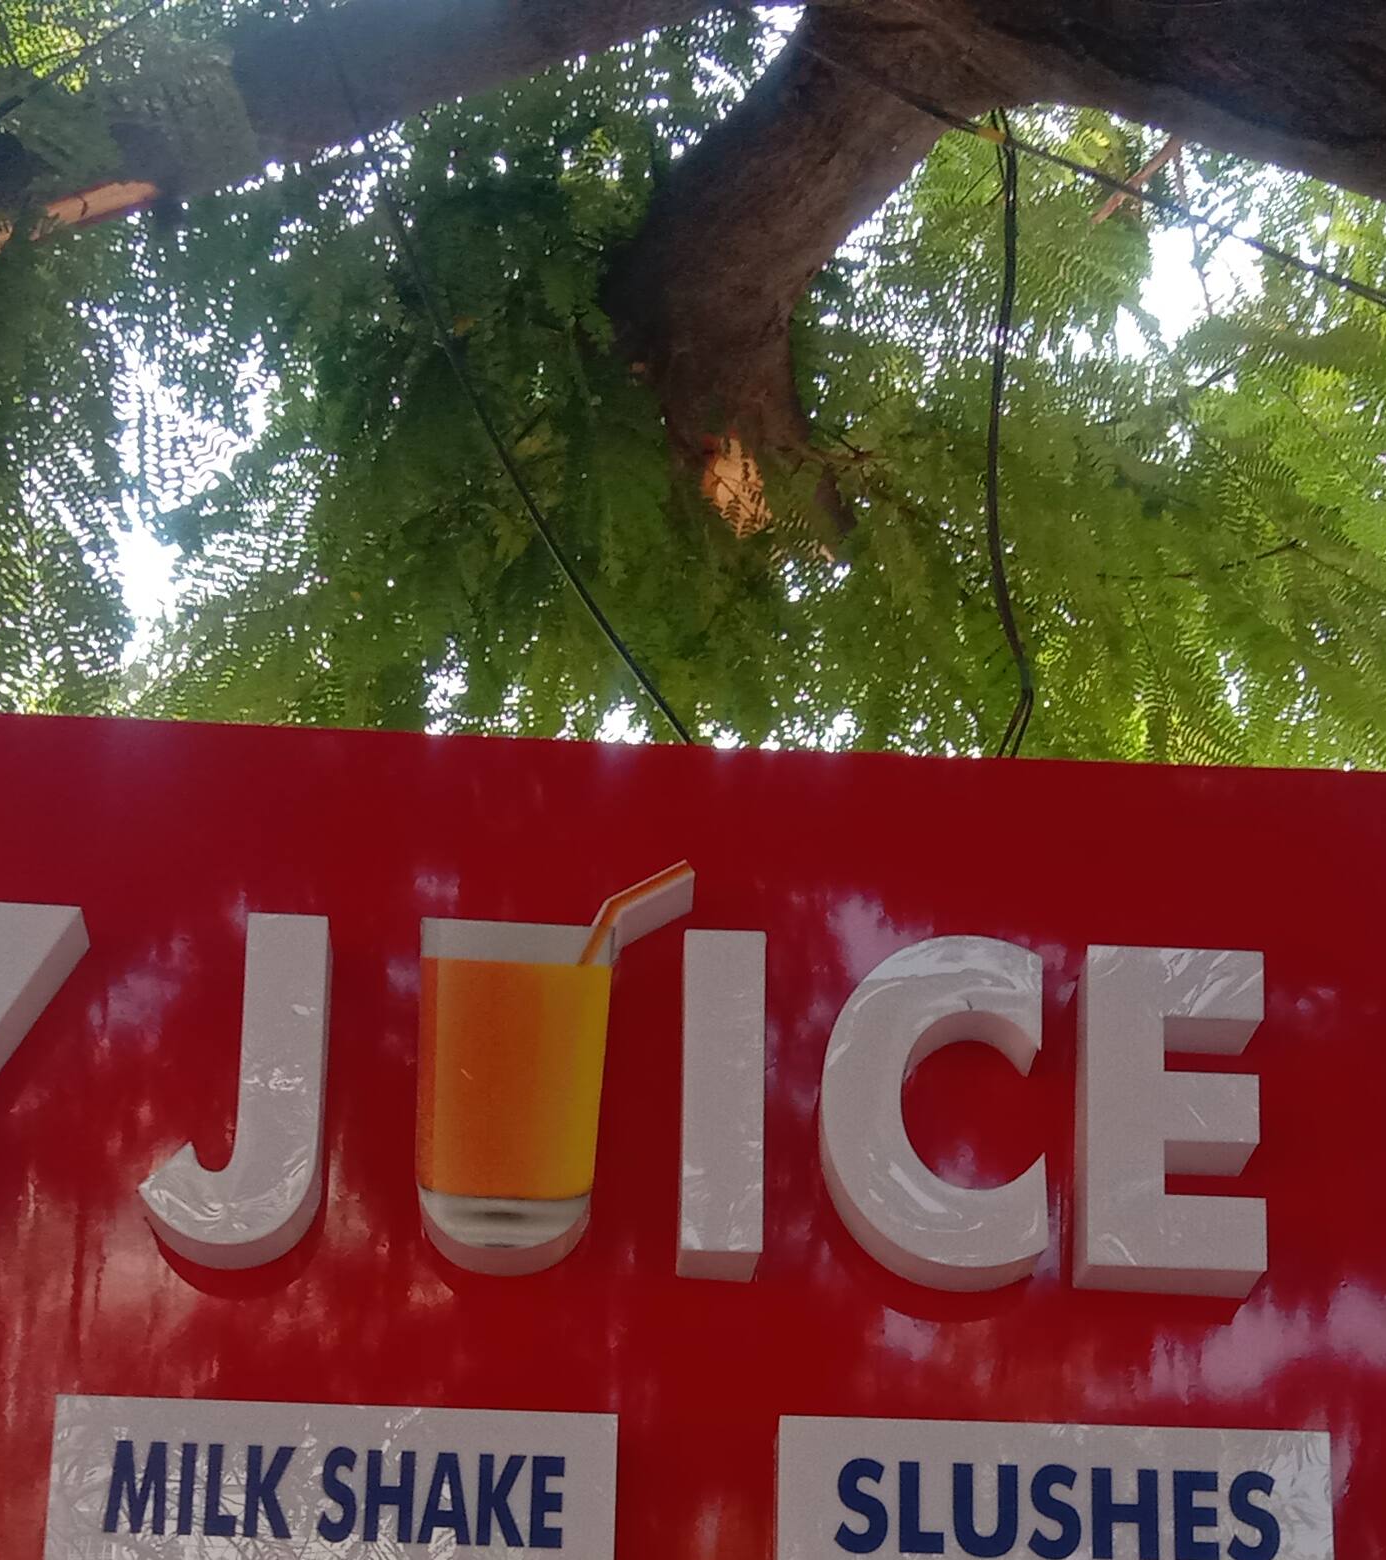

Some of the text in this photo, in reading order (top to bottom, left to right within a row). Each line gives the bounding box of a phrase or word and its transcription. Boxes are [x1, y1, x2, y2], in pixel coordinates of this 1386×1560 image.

[137, 860, 1269, 1299] JUICE
[103, 1439, 566, 1549] MILK SHAKE
